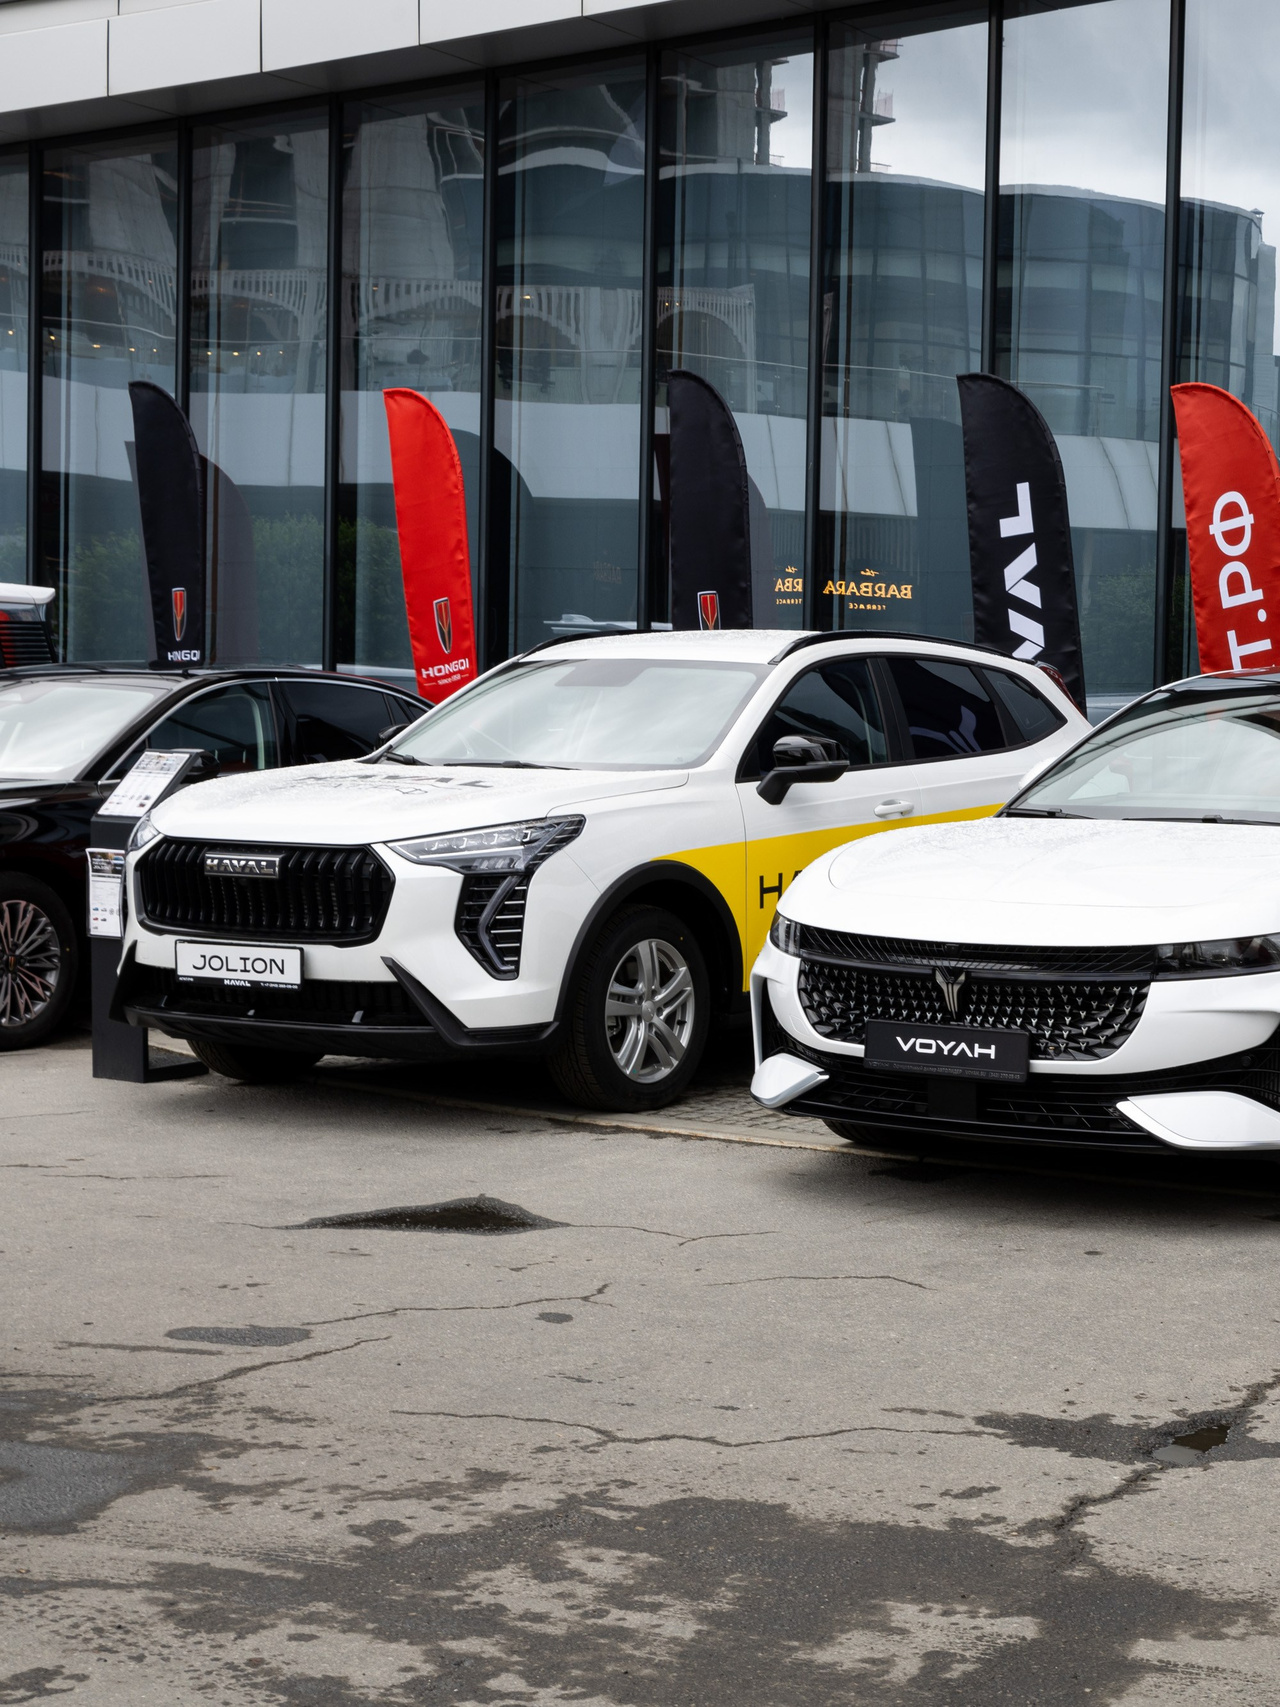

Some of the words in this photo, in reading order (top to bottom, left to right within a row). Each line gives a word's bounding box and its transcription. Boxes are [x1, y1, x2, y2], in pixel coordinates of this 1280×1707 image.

[421, 657, 470, 679] HONGQI
[206, 858, 274, 874] HAVAL
[192, 954, 285, 975] JOLION
[224, 979, 251, 987] HAVAL
[896, 1036, 996, 1060] VOYAH
